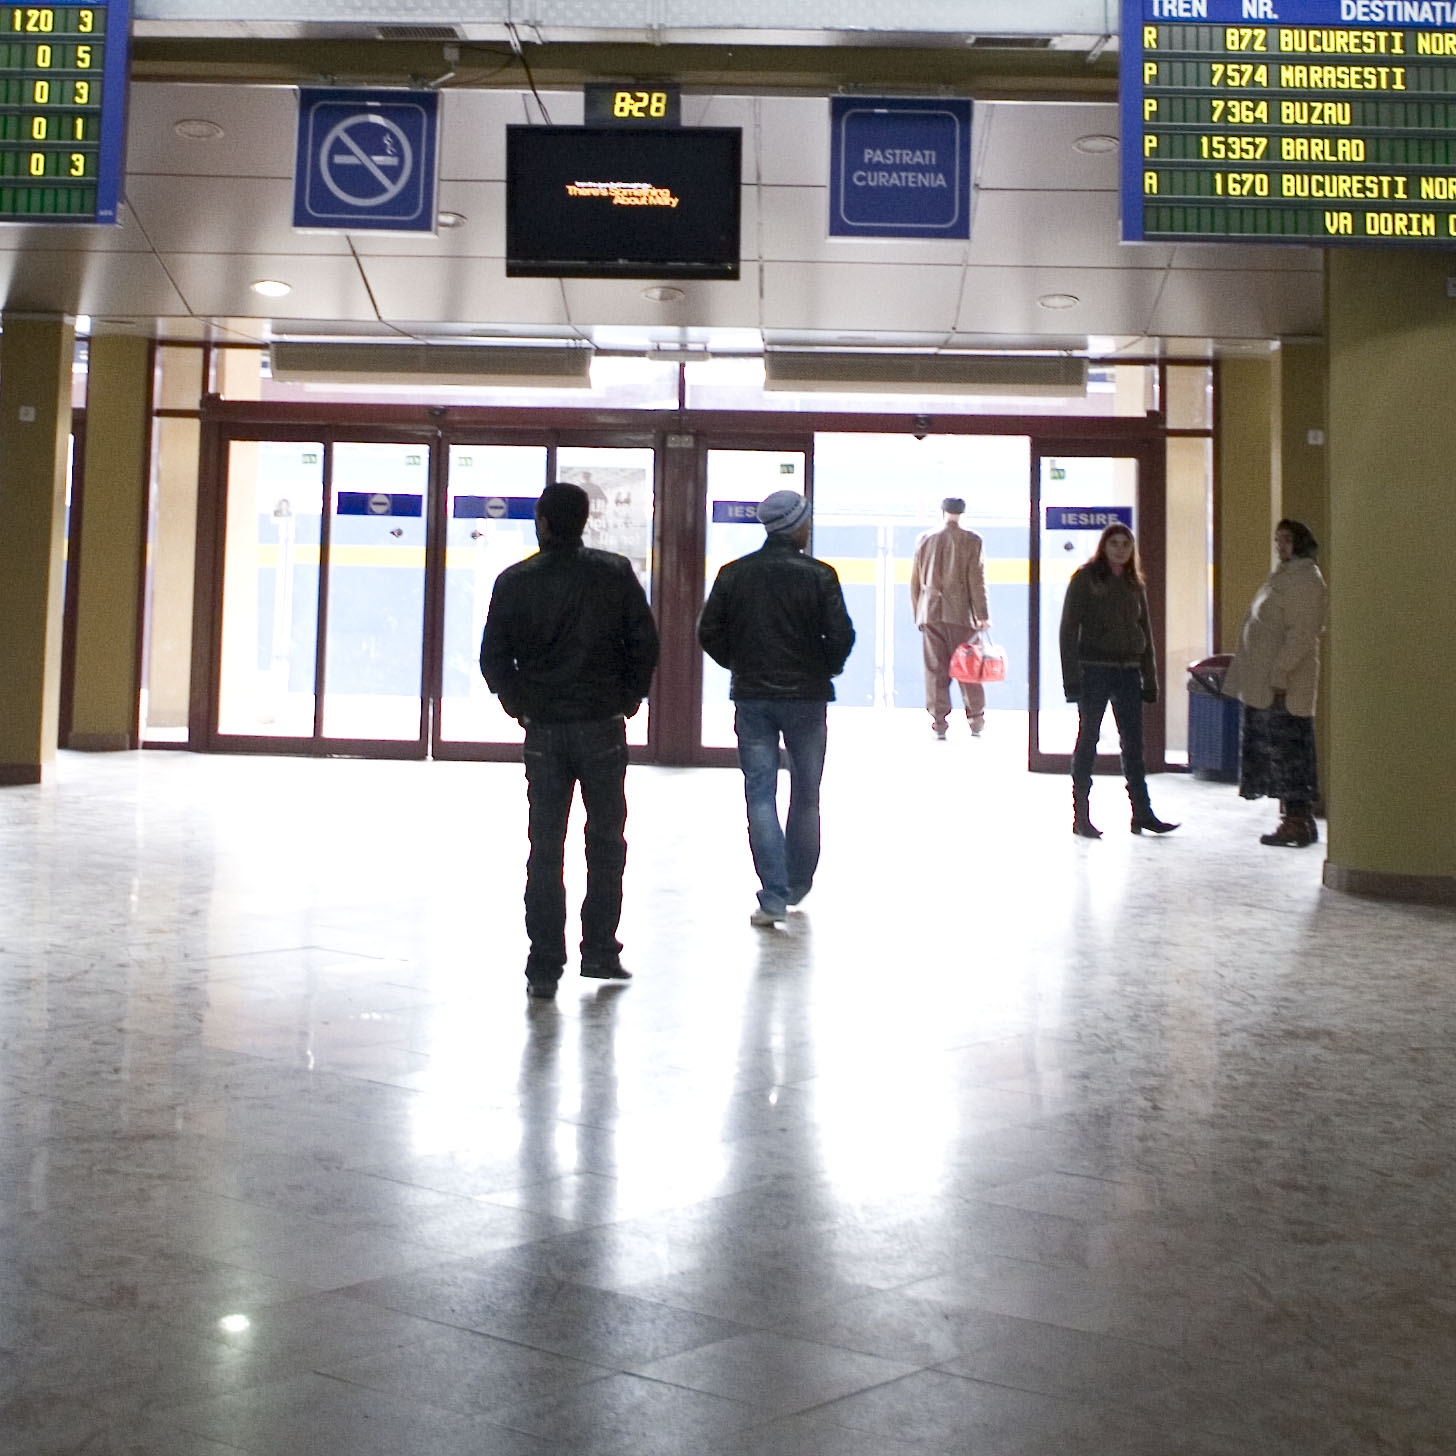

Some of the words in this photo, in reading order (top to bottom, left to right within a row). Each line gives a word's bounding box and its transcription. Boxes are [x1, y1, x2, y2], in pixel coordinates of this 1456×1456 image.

[14, 8, 54, 32] 120
[78, 9, 93, 33] 3
[1143, 26, 1157, 49] R
[1225, 27, 1267, 52] 872
[1279, 28, 1405, 54] BUCURESTI
[36, 45, 51, 68] 0
[76, 45, 91, 69] 5
[1143, 62, 1158, 85] P
[1211, 63, 1268, 90] 7574
[1280, 64, 1406, 90] MARASESTI
[34, 80, 49, 104] 0
[74, 81, 89, 104] 3
[613, 91, 668, 119] 8:28
[1143, 98, 1158, 121] P
[1211, 99, 1268, 124] 7364
[1281, 101, 1351, 125] BUZAU
[32, 116, 47, 140] 0
[75, 117, 83, 140] 1
[863, 148, 937, 166] PASTRATI
[1144, 134, 1158, 157] P
[1200, 135, 1268, 160] 15357
[1281, 137, 1365, 162] BARLAD
[30, 152, 45, 176] 0
[70, 153, 85, 177] 3
[852, 170, 948, 189] CURATENIA
[1144, 171, 1158, 194] A
[1214, 172, 1269, 197] 1670
[1282, 173, 1408, 199] BUCURESTI
[1325, 211, 1353, 235] VA
[1365, 212, 1436, 236] DORIM
[1061, 512, 1119, 526] IESIRE
